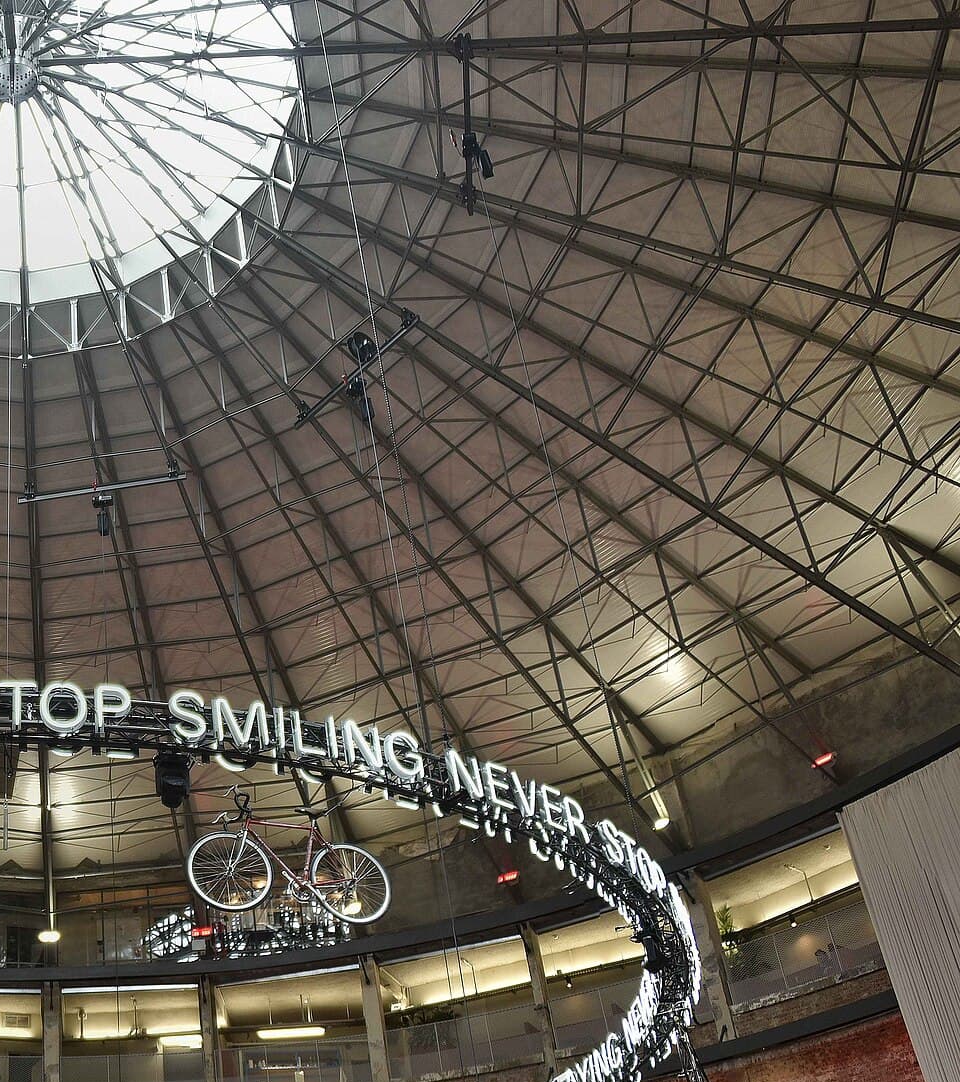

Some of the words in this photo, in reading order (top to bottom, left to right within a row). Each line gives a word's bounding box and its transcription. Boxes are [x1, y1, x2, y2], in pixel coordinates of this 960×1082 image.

[168, 690, 424, 778] SMILING
[444, 749, 591, 844] NEVER
[598, 819, 667, 898] STOP
